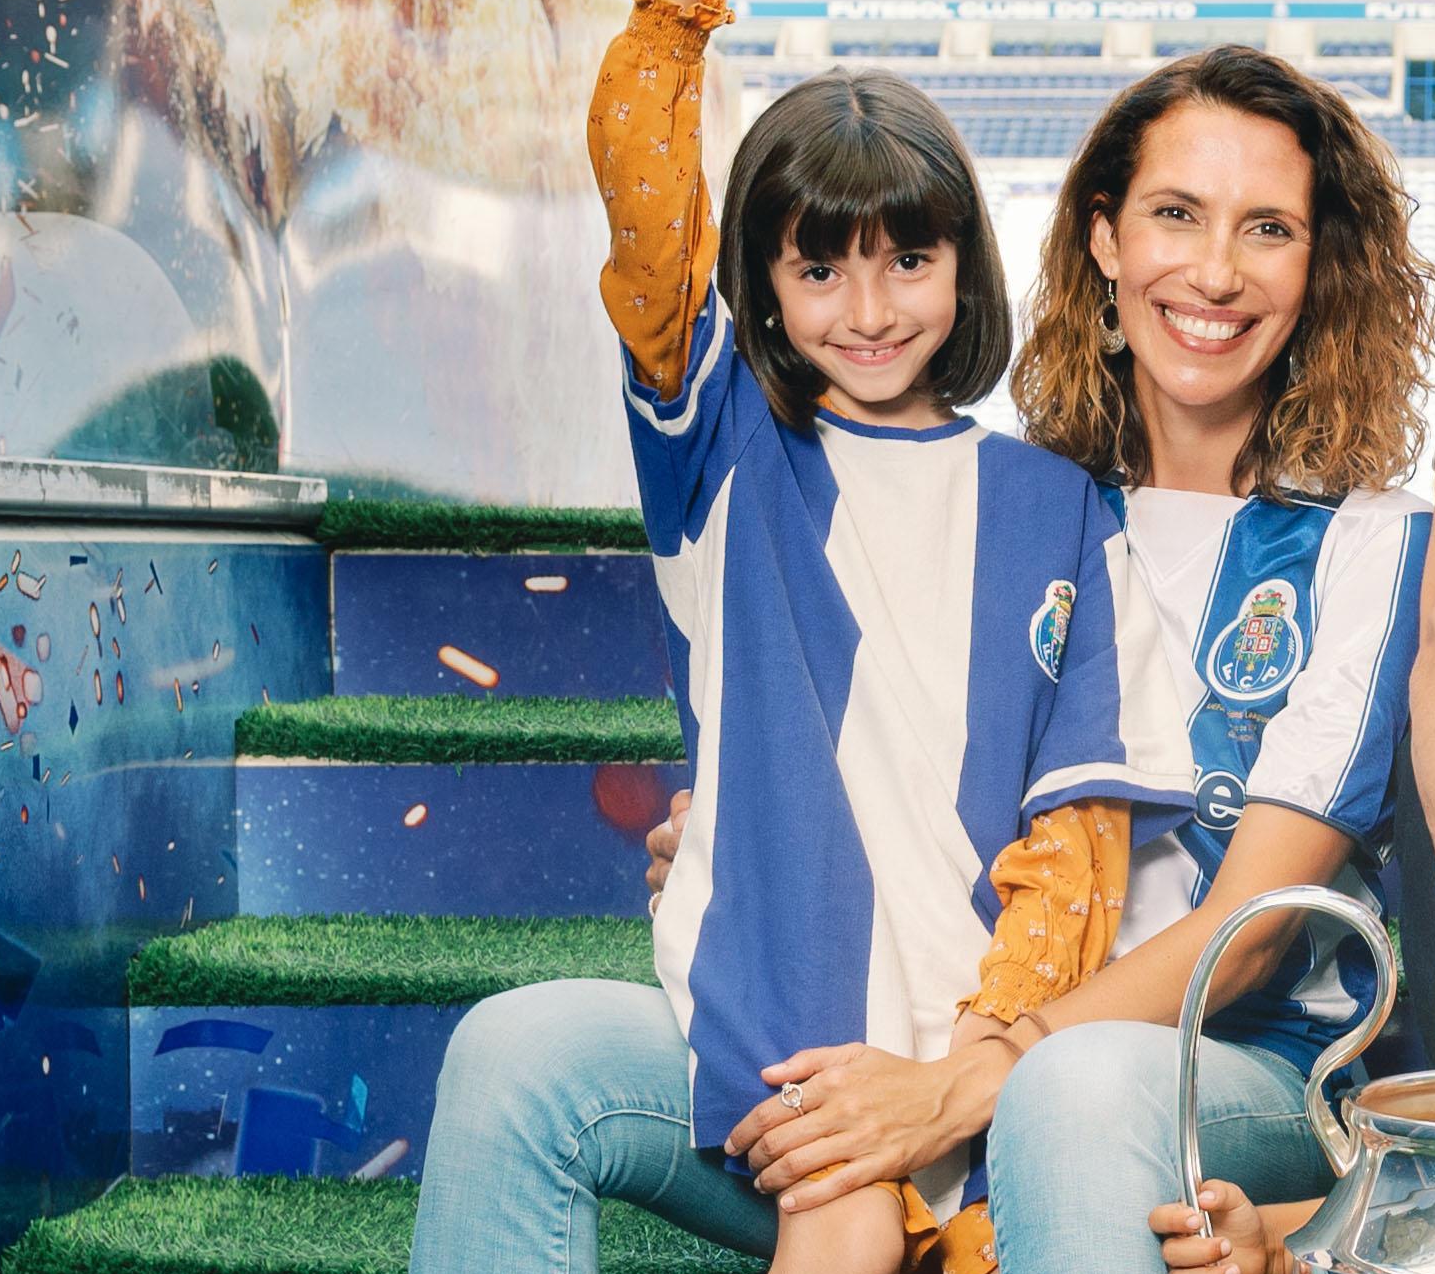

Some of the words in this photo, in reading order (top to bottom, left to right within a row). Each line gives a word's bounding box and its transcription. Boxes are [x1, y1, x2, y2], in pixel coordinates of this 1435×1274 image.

[828, 1, 953, 20] FUTEBOL
[958, 1, 1048, 20] CLUBE
[1055, 1, 1094, 20] DO
[1101, 1, 1196, 20] PORTO
